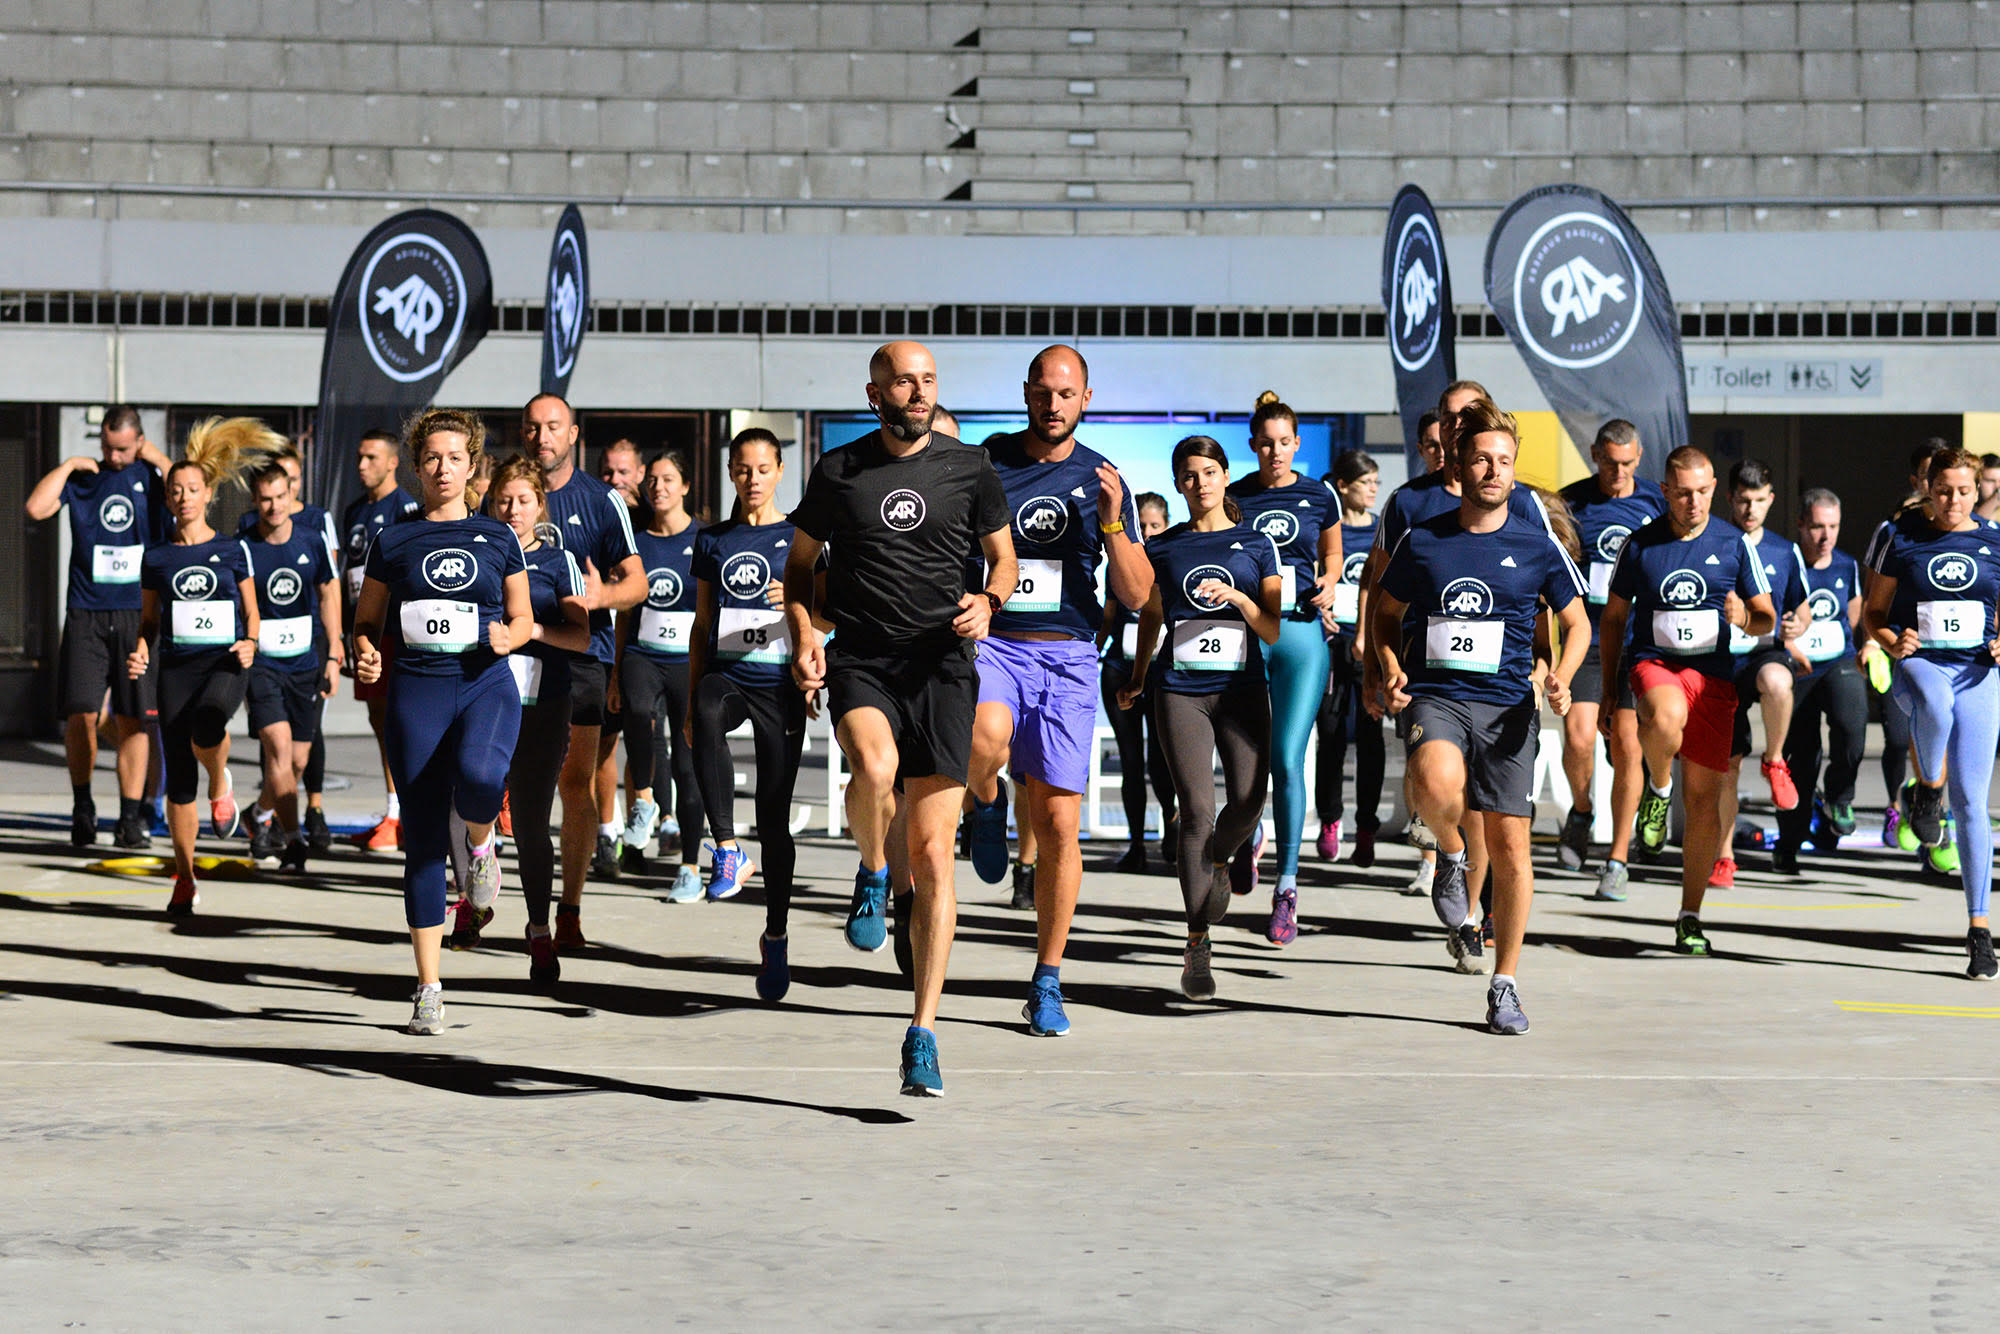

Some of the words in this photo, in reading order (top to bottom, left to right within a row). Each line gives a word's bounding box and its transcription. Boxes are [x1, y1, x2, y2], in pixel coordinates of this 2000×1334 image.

[373, 273, 444, 356] AR
[1715, 366, 1771, 388] Toilet
[888, 500, 917, 520] AR
[1024, 508, 1057, 531] AR
[1260, 518, 1289, 536] AR
[431, 558, 468, 579] AR
[728, 564, 761, 586] AR
[1935, 561, 1968, 581] AR
[1668, 581, 1698, 600] AR
[1447, 591, 1482, 613] AR
[195, 617, 213, 630] 26
[426, 619, 451, 635] 08
[1943, 619, 1960, 632] 15
[279, 633, 296, 645] 23
[658, 627, 677, 639] 25
[743, 629, 767, 645] 03
[1677, 628, 1693, 641] 15
[1199, 638, 1221, 653] 28
[1451, 636, 1474, 653] 28
[1810, 638, 1823, 649] 21
